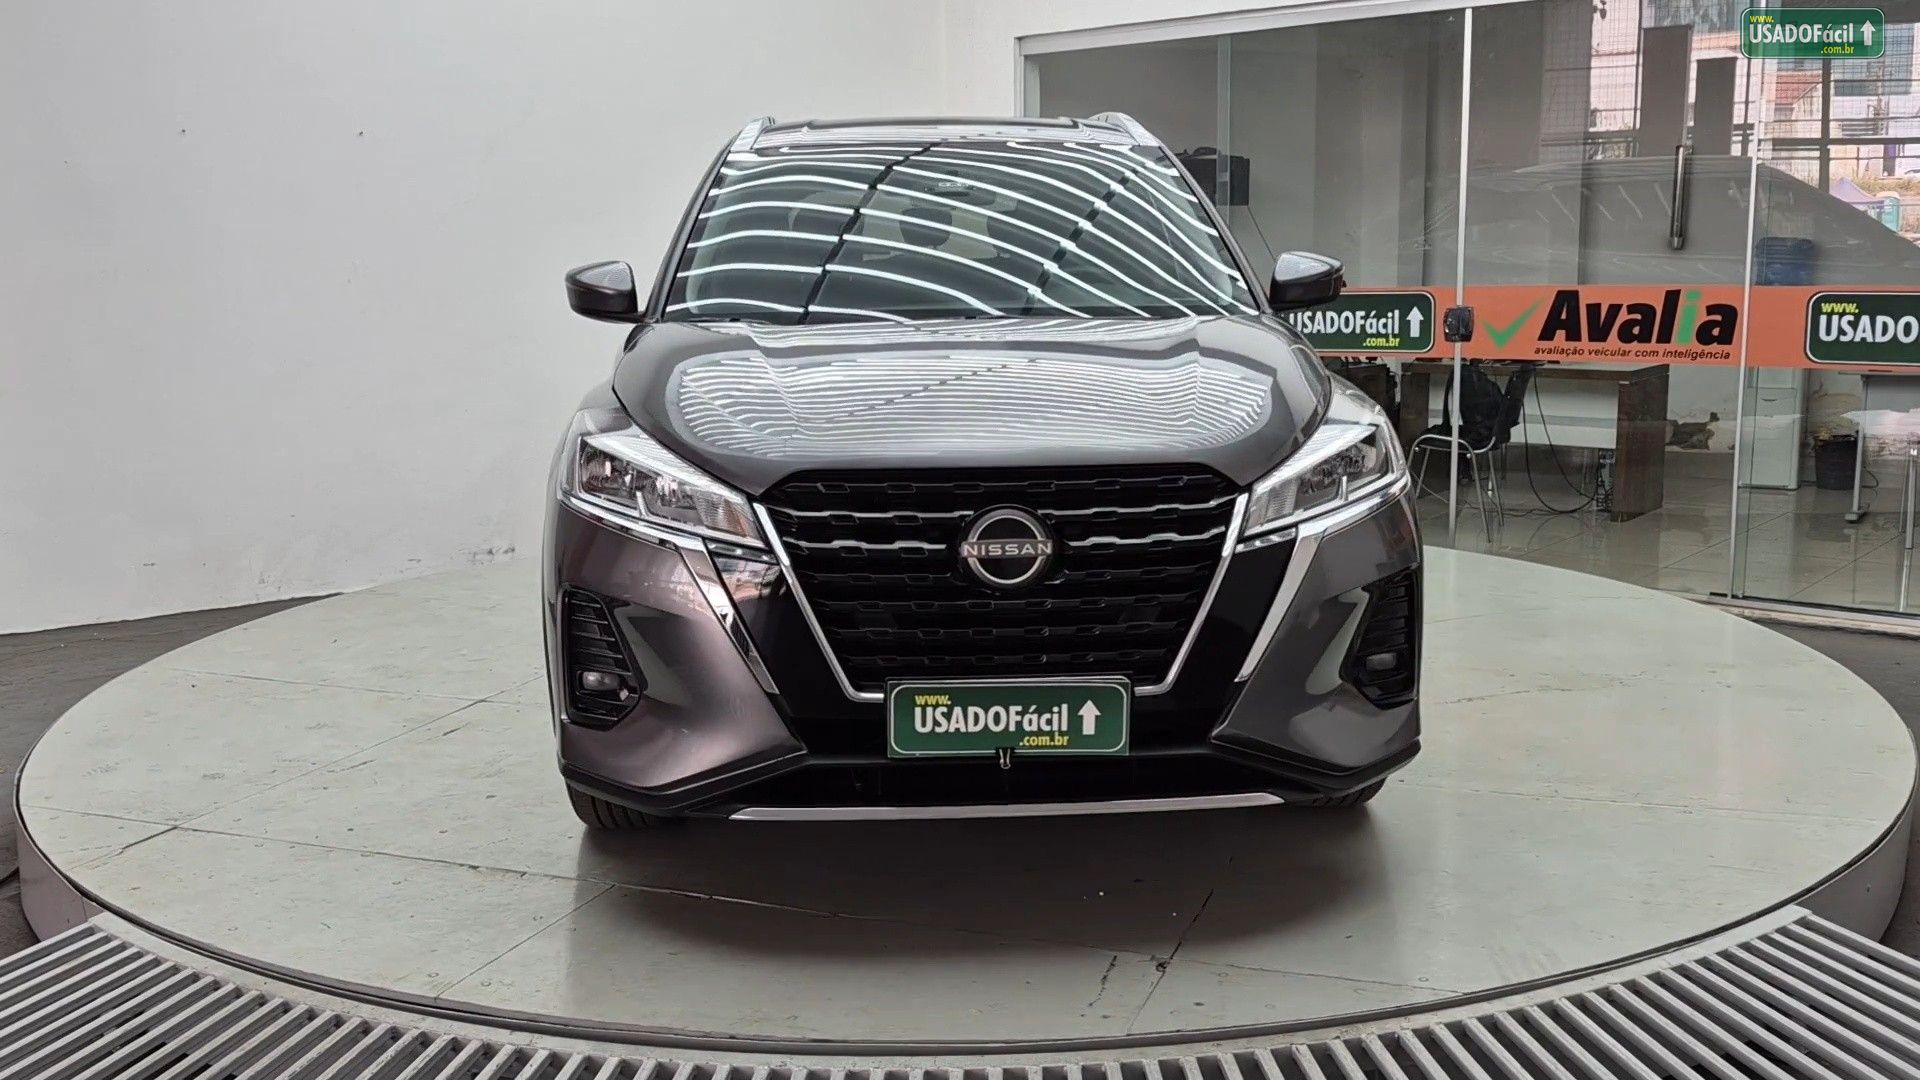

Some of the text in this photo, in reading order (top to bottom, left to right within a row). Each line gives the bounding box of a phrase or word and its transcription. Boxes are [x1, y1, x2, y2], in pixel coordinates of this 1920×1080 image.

[1820, 302, 1859, 313] www.
[1537, 289, 1739, 346] Avalia
[1362, 335, 1401, 347] .com.br
[1533, 345, 1731, 361] avaliação veicular com inteligência
[963, 542, 1053, 556] NISSAN
[914, 694, 952, 706] www.
[913, 703, 1069, 734] USADOFácil
[1018, 732, 1070, 747] .com.br
